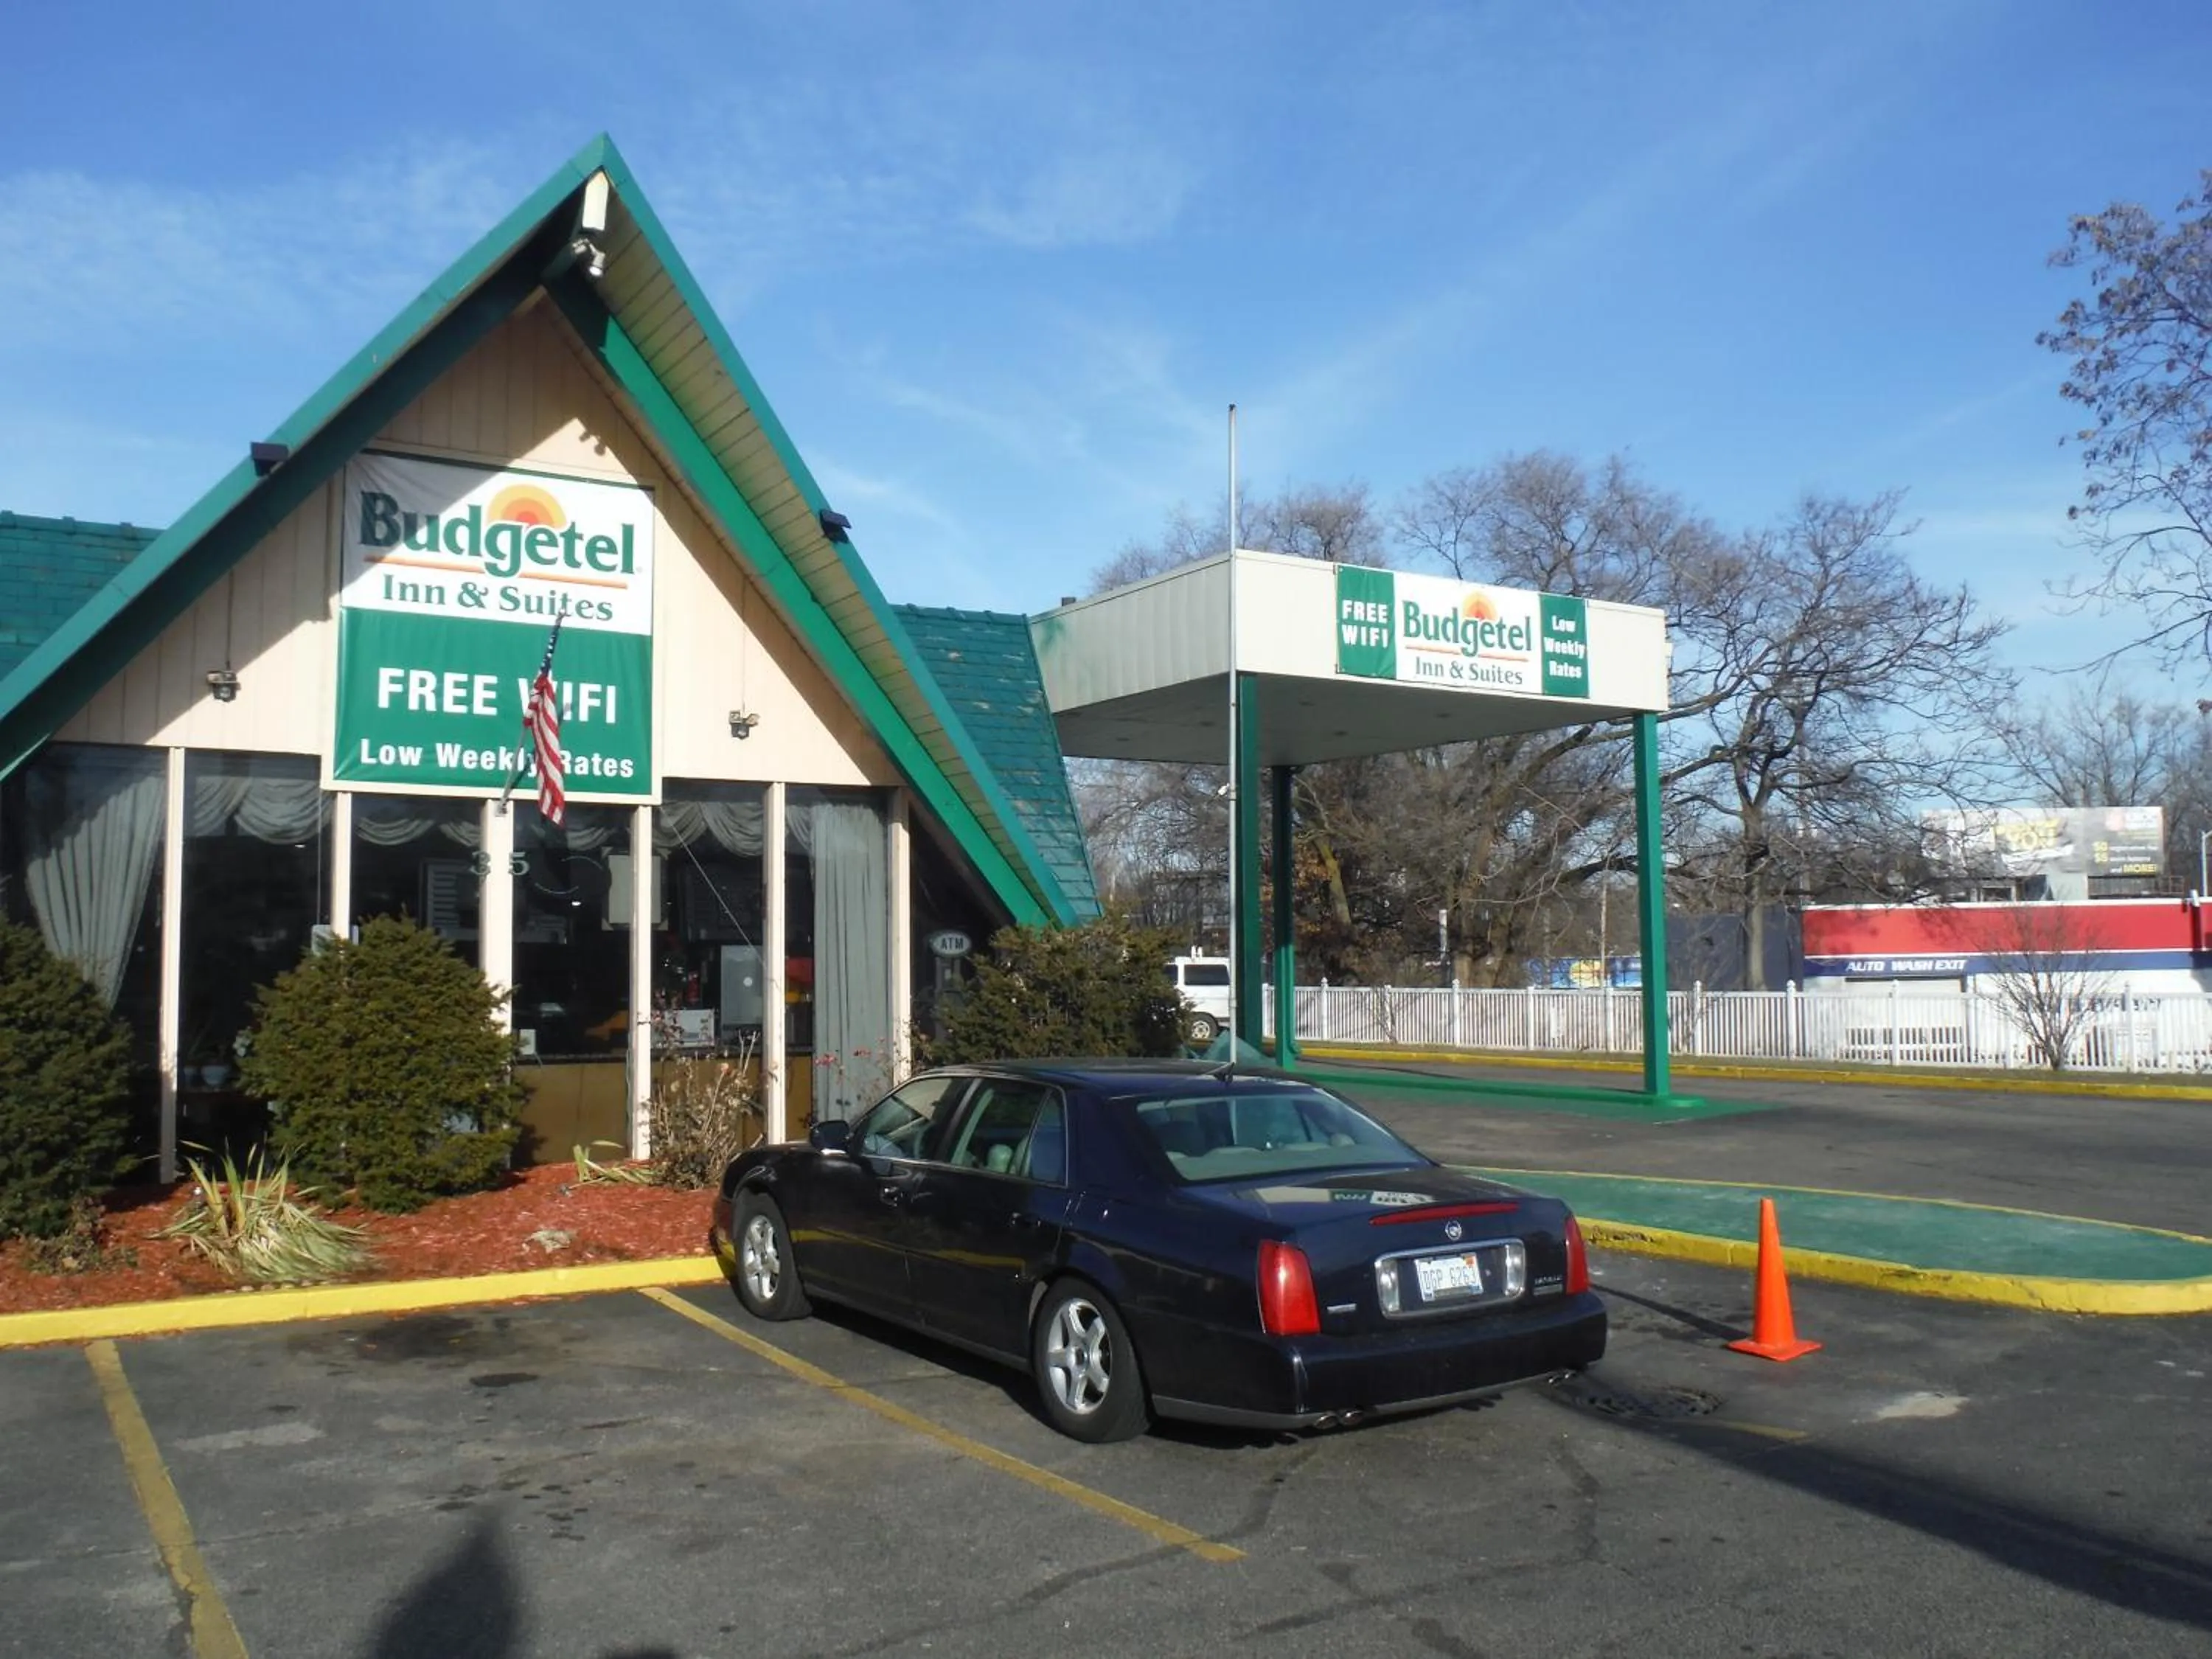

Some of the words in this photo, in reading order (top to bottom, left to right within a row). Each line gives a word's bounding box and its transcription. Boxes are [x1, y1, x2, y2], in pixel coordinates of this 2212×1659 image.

[360, 490, 636, 577] Budgetel
[383, 574, 445, 605] Inn
[457, 582, 488, 609] &
[499, 586, 613, 621] Suites
[1342, 600, 1388, 624] FREE
[1551, 615, 1576, 633] Low
[1342, 625, 1389, 649] WIFI
[1402, 600, 1531, 657] Budgetel
[1543, 636, 1585, 659] Weekly
[1415, 656, 1444, 677] Inn
[1450, 661, 1464, 680] &
[1469, 662, 1523, 685] Suites
[1549, 660, 1582, 678] Rates
[378, 667, 498, 716] FREE
[360, 739, 422, 766] Low
[942, 937, 964, 950] ATM
[1846, 961, 1885, 972] AUTO
[1891, 960, 1933, 971] WASH
[1935, 959, 1968, 970] EXIT
